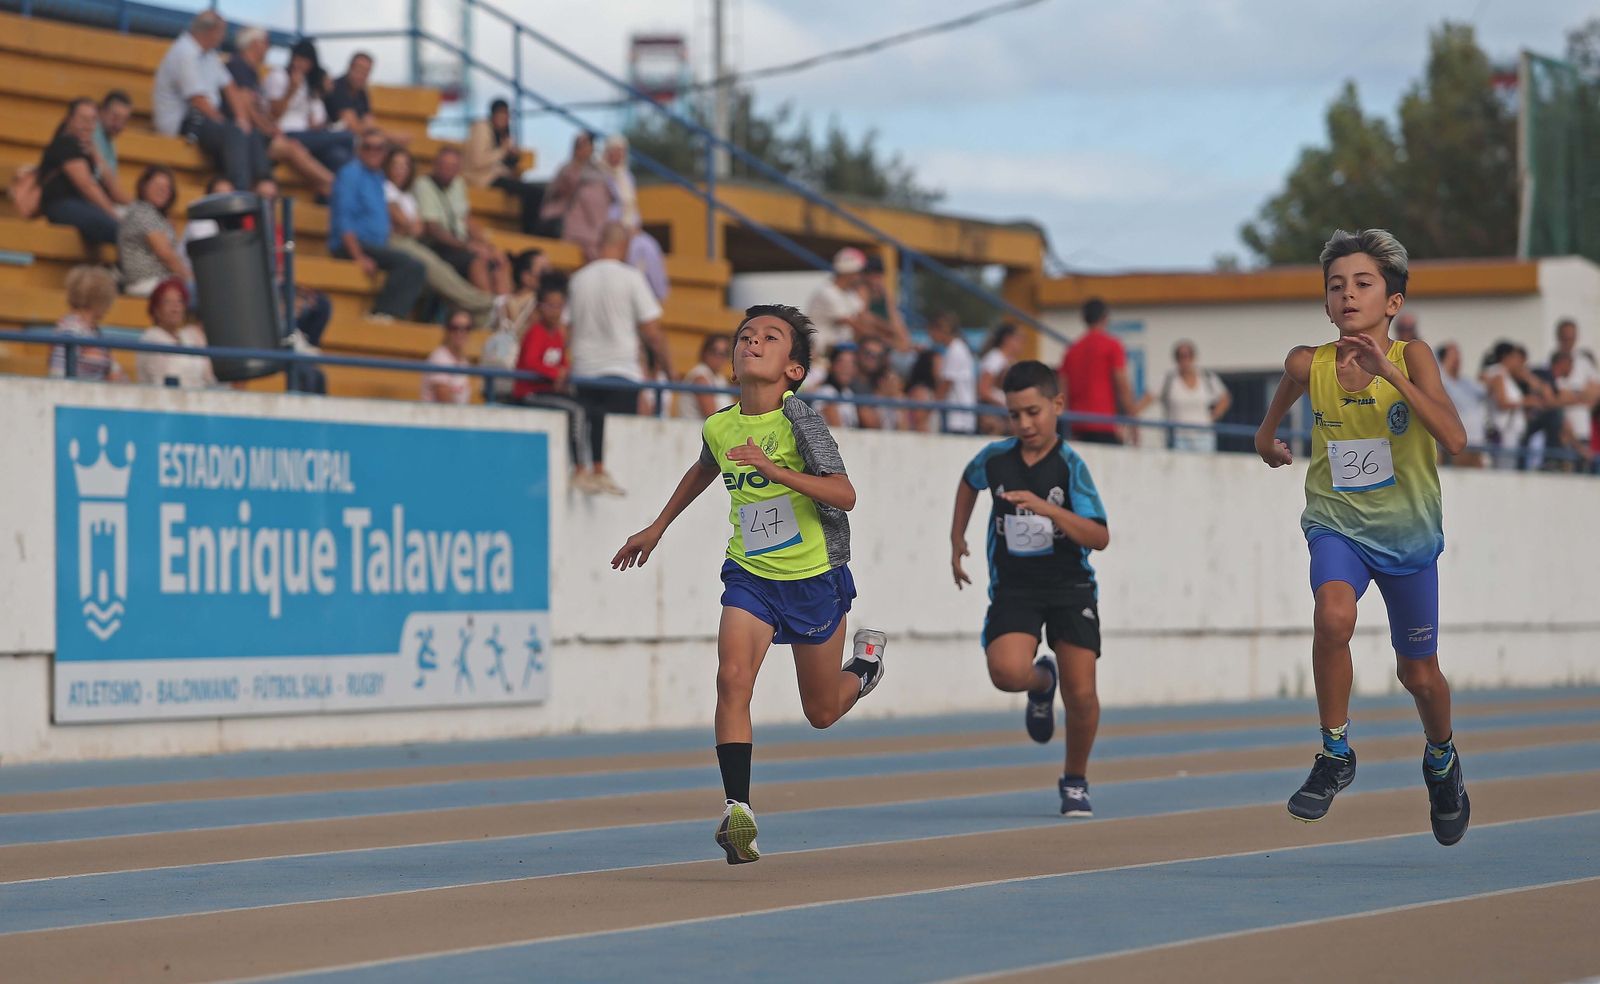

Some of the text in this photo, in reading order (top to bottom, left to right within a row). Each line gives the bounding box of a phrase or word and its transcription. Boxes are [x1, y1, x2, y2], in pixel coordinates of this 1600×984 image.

[158, 443, 355, 492] ESTADIO MUNICIPAL
[1342, 450, 1379, 479] 36
[751, 508, 783, 538] 47
[1016, 521, 1047, 548] 33
[160, 501, 513, 618] Enrique Talavera
[68, 679, 143, 707] ATLETISMO
[156, 676, 241, 704] BALONMANO
[301, 673, 334, 699] SALA
[345, 672, 384, 697] RUGBY
